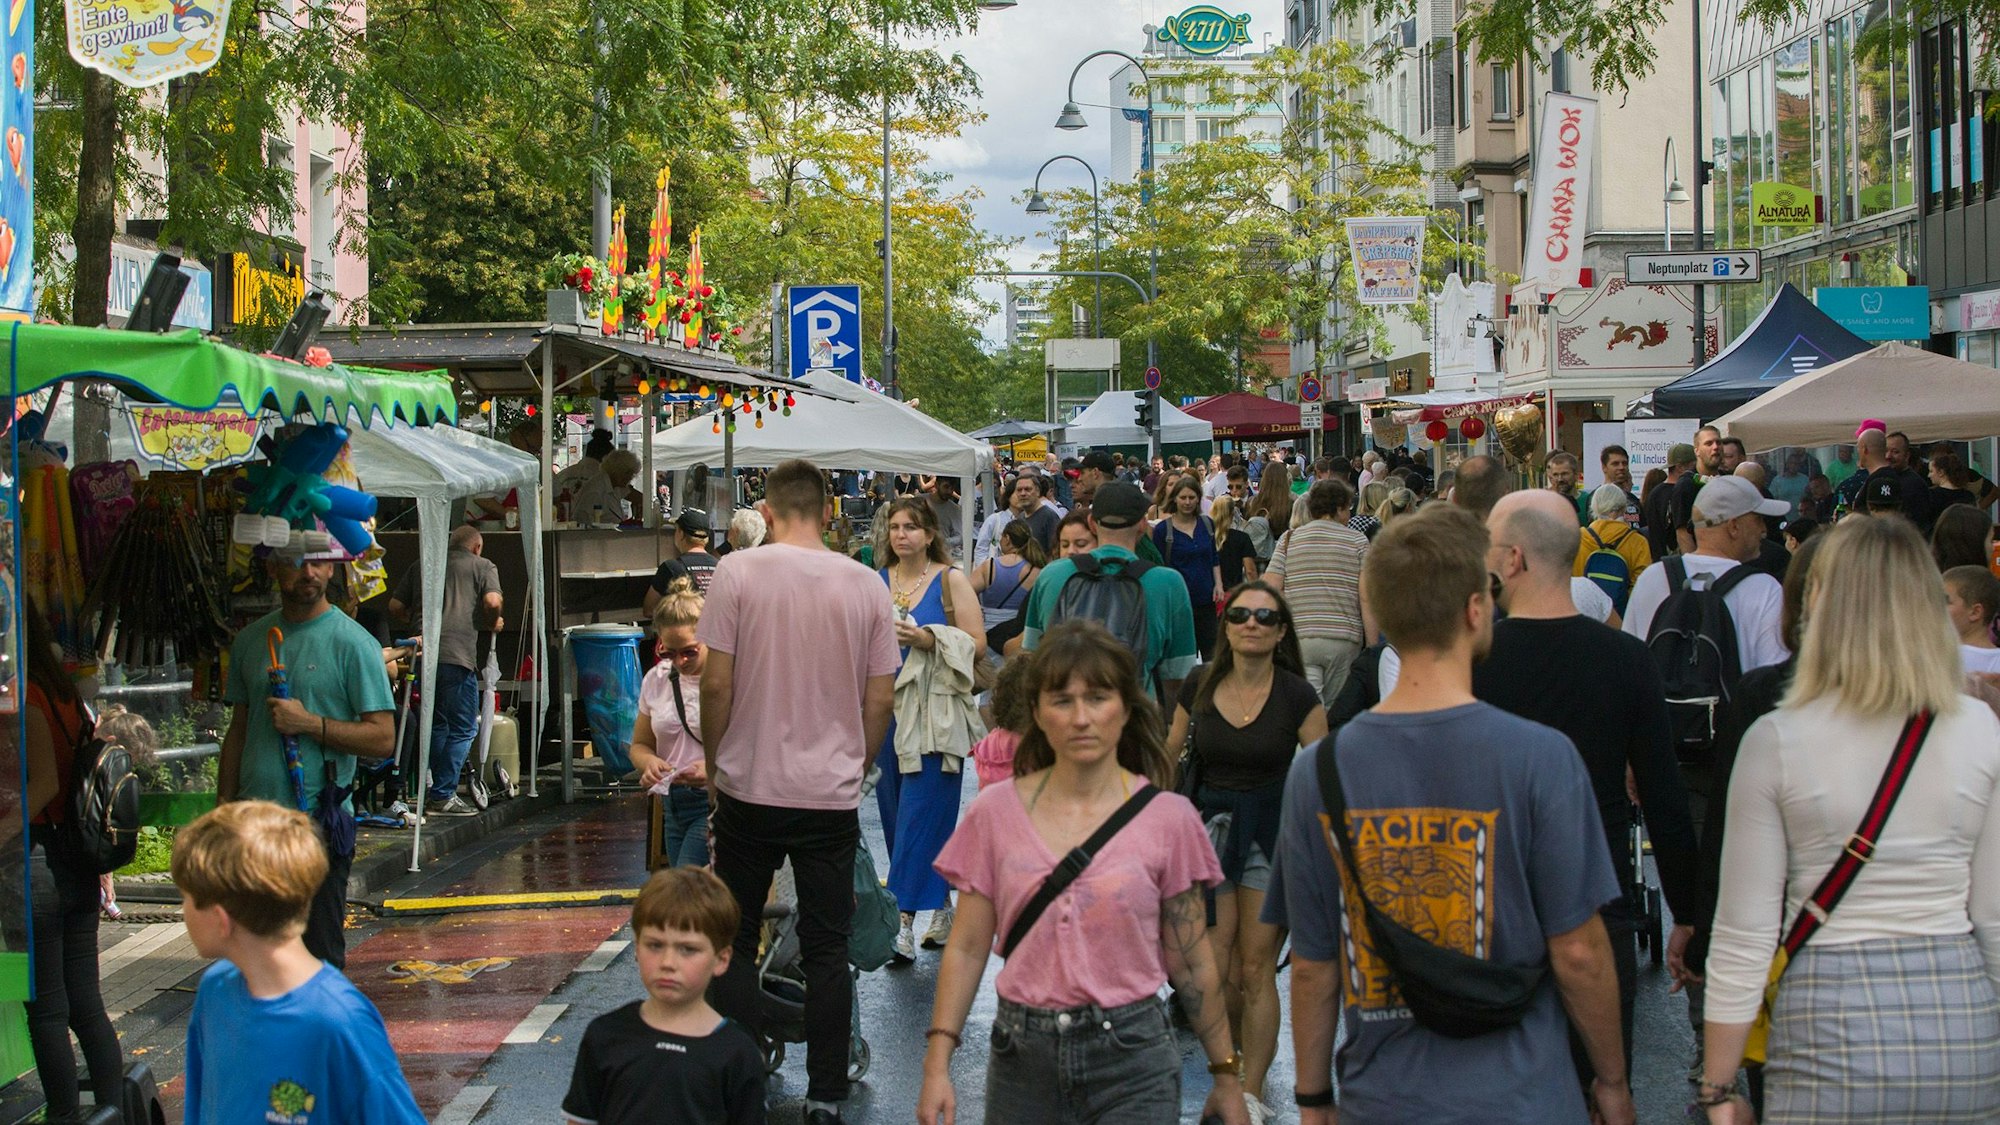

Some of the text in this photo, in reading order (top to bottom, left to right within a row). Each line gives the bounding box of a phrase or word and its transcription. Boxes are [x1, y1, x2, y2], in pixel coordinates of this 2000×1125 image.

[82, 4, 128, 30] Ente
[82, 13, 168, 57] gewinnt!
[1545, 107, 1583, 262] CHINA WOK
[1758, 204, 1811, 217] ALNATURA
[1648, 261, 1708, 276] Neptunplatz
[1363, 287, 1414, 298] WAFFELN
[1892, 317, 1915, 325] MORE
[807, 310, 841, 359] P
[1443, 404, 1478, 418] CHINA
[1631, 454, 1667, 464] All Inclus
